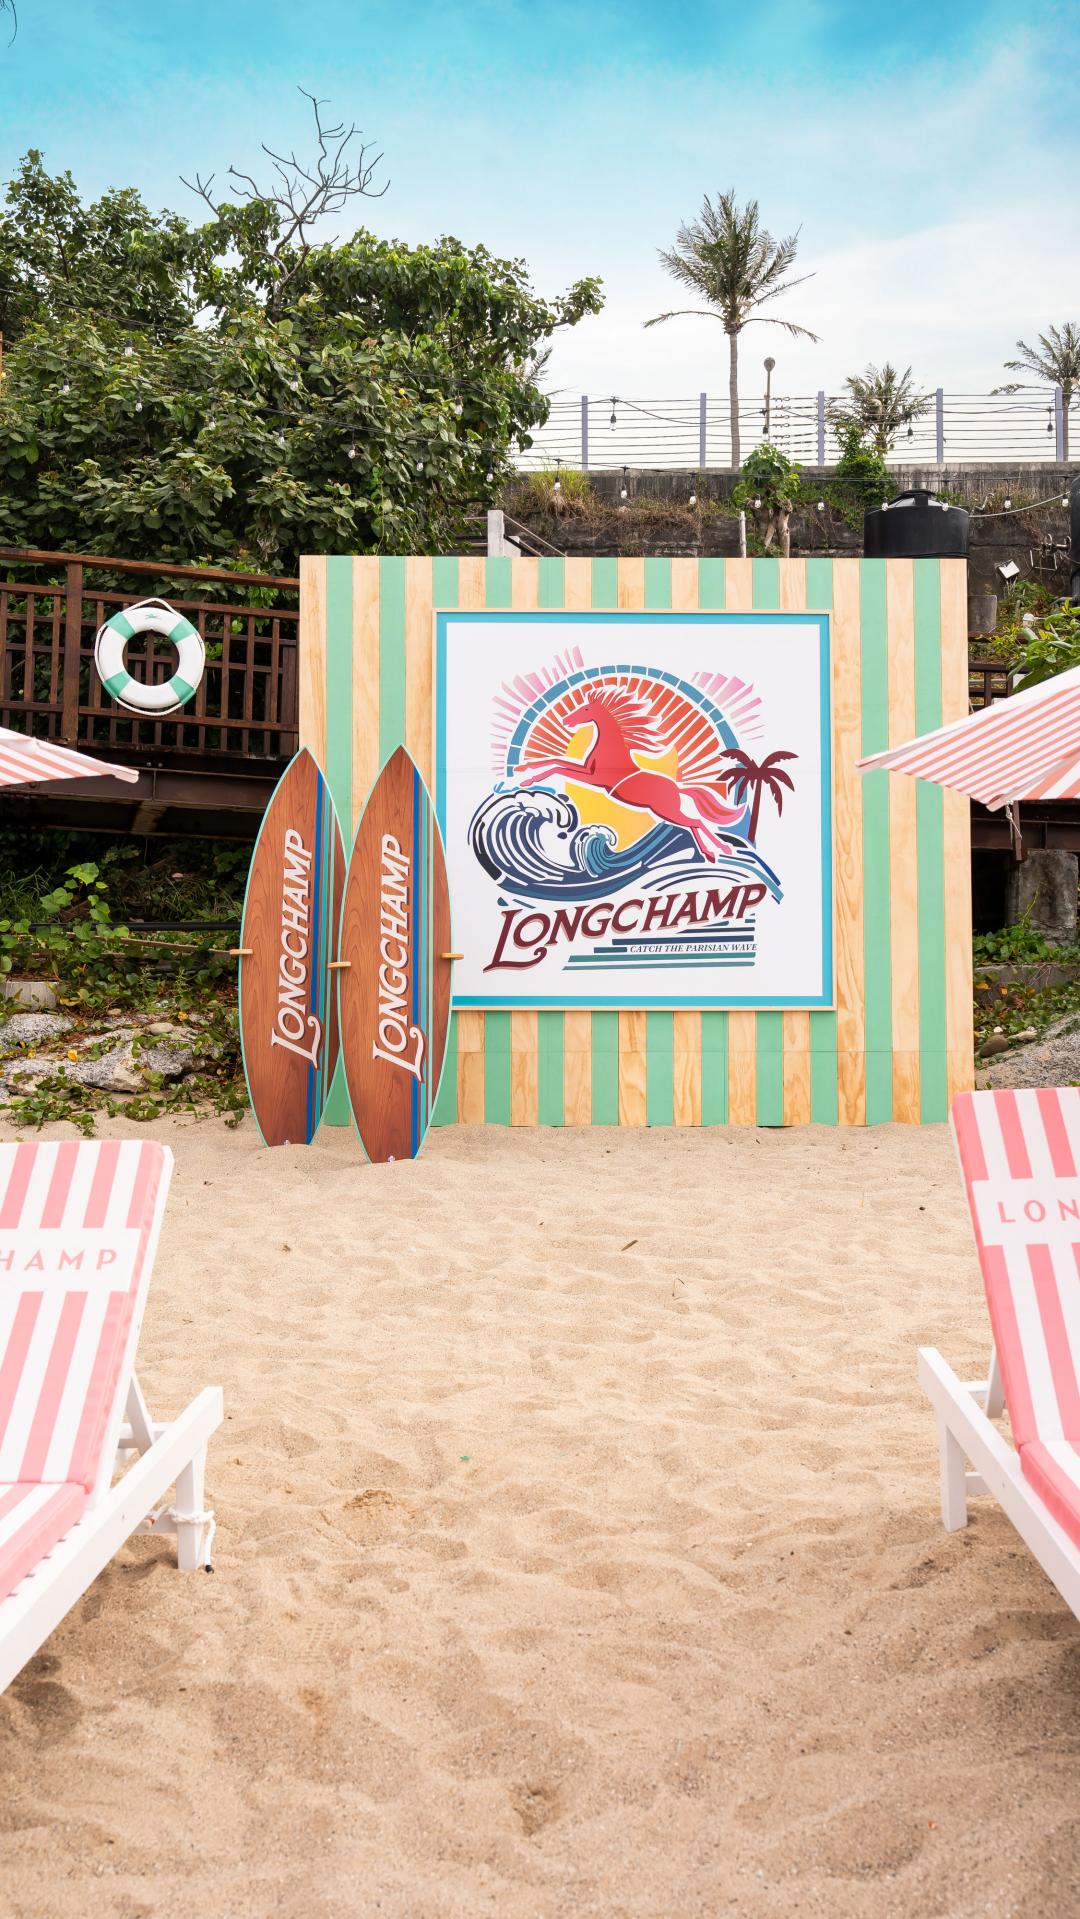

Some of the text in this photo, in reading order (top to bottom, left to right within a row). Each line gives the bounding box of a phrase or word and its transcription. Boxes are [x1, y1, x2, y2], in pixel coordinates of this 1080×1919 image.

[273, 829, 320, 1069] LONGCHAMP
[373, 834, 424, 1083] LONGCHAMP
[482, 883, 767, 973] LONGCHAMP
[630, 943, 758, 953] CATCH THE PARISIAN WAVE
[997, 1199, 1080, 1223] LON
